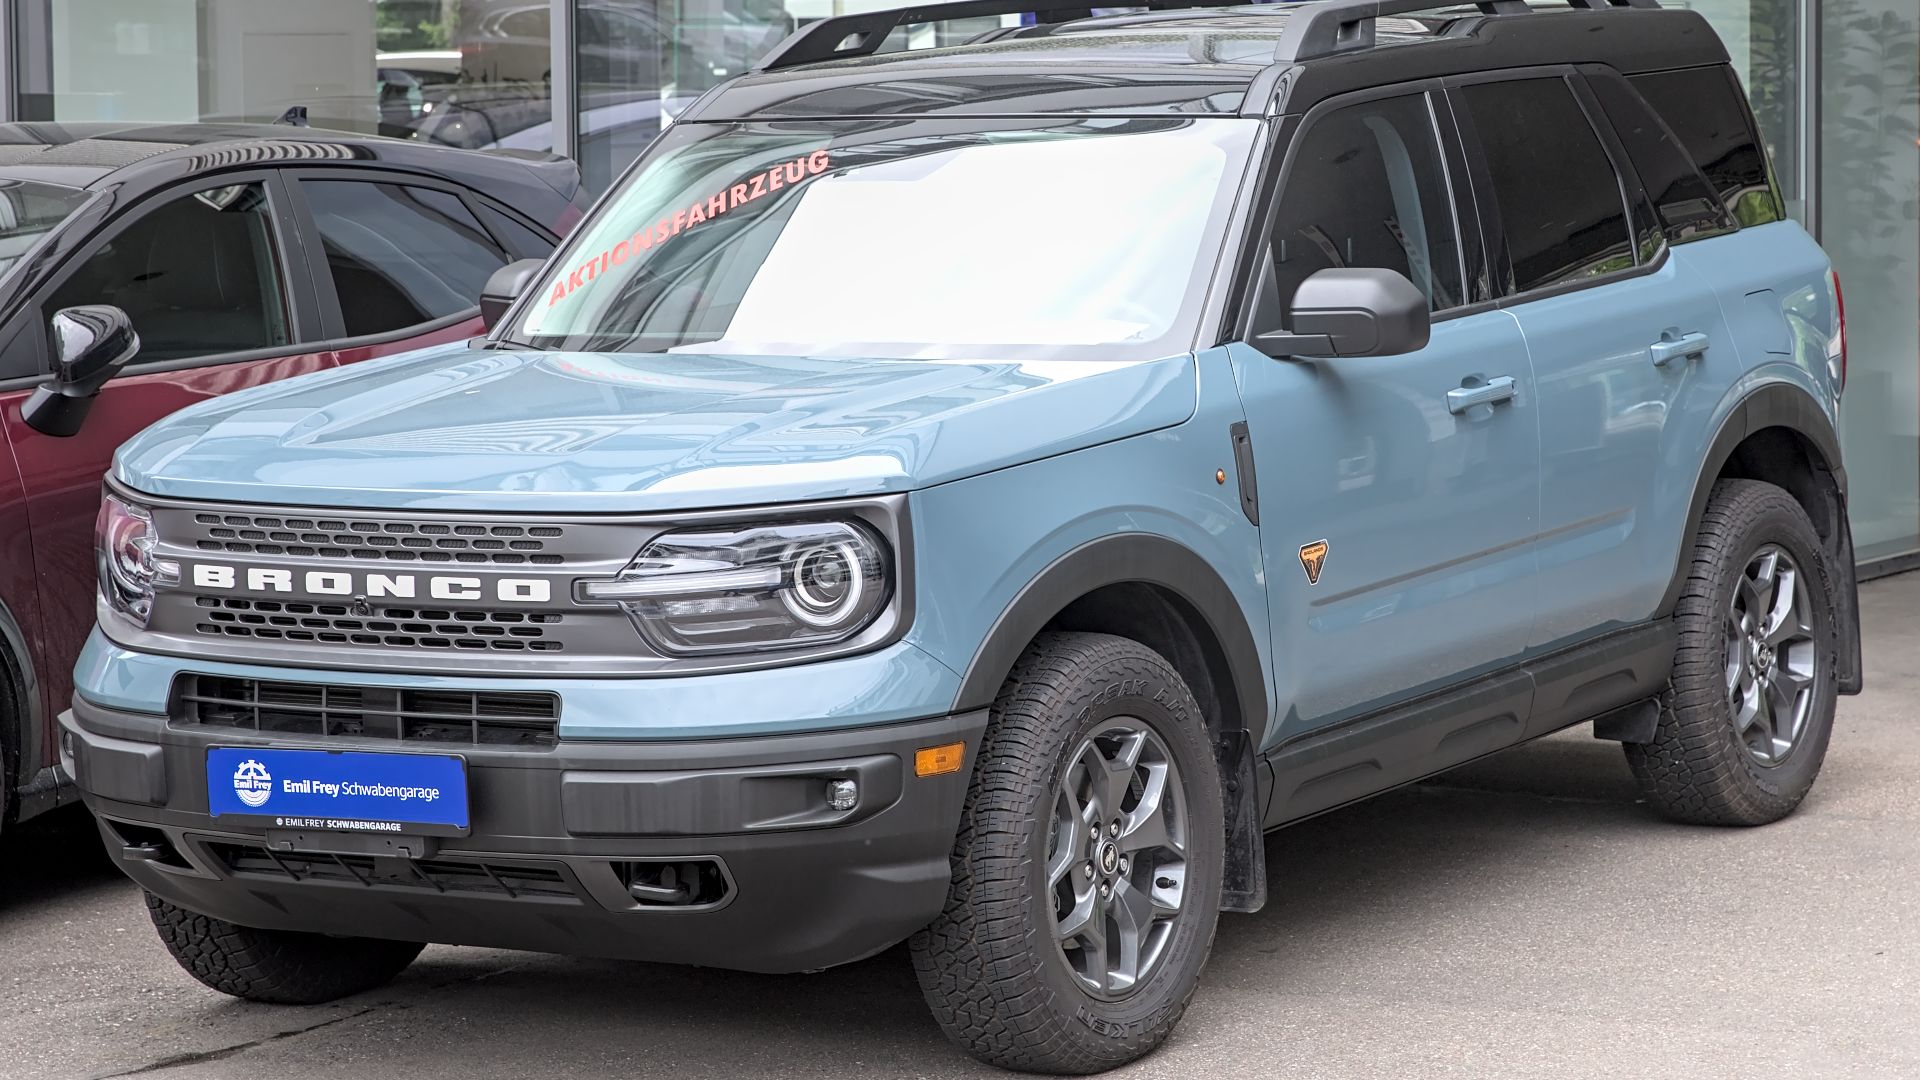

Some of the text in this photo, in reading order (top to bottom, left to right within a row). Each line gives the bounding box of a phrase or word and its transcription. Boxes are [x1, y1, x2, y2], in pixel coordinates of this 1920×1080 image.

[548, 149, 830, 307] AKTIONSFAHRZEUG
[193, 564, 551, 602] BRONCO
[233, 779, 272, 791] Emil Frey
[283, 779, 440, 802] Emil Frey Schwabengarage
[285, 817, 402, 832] EMIL FREY SCHWABENGARAGE
